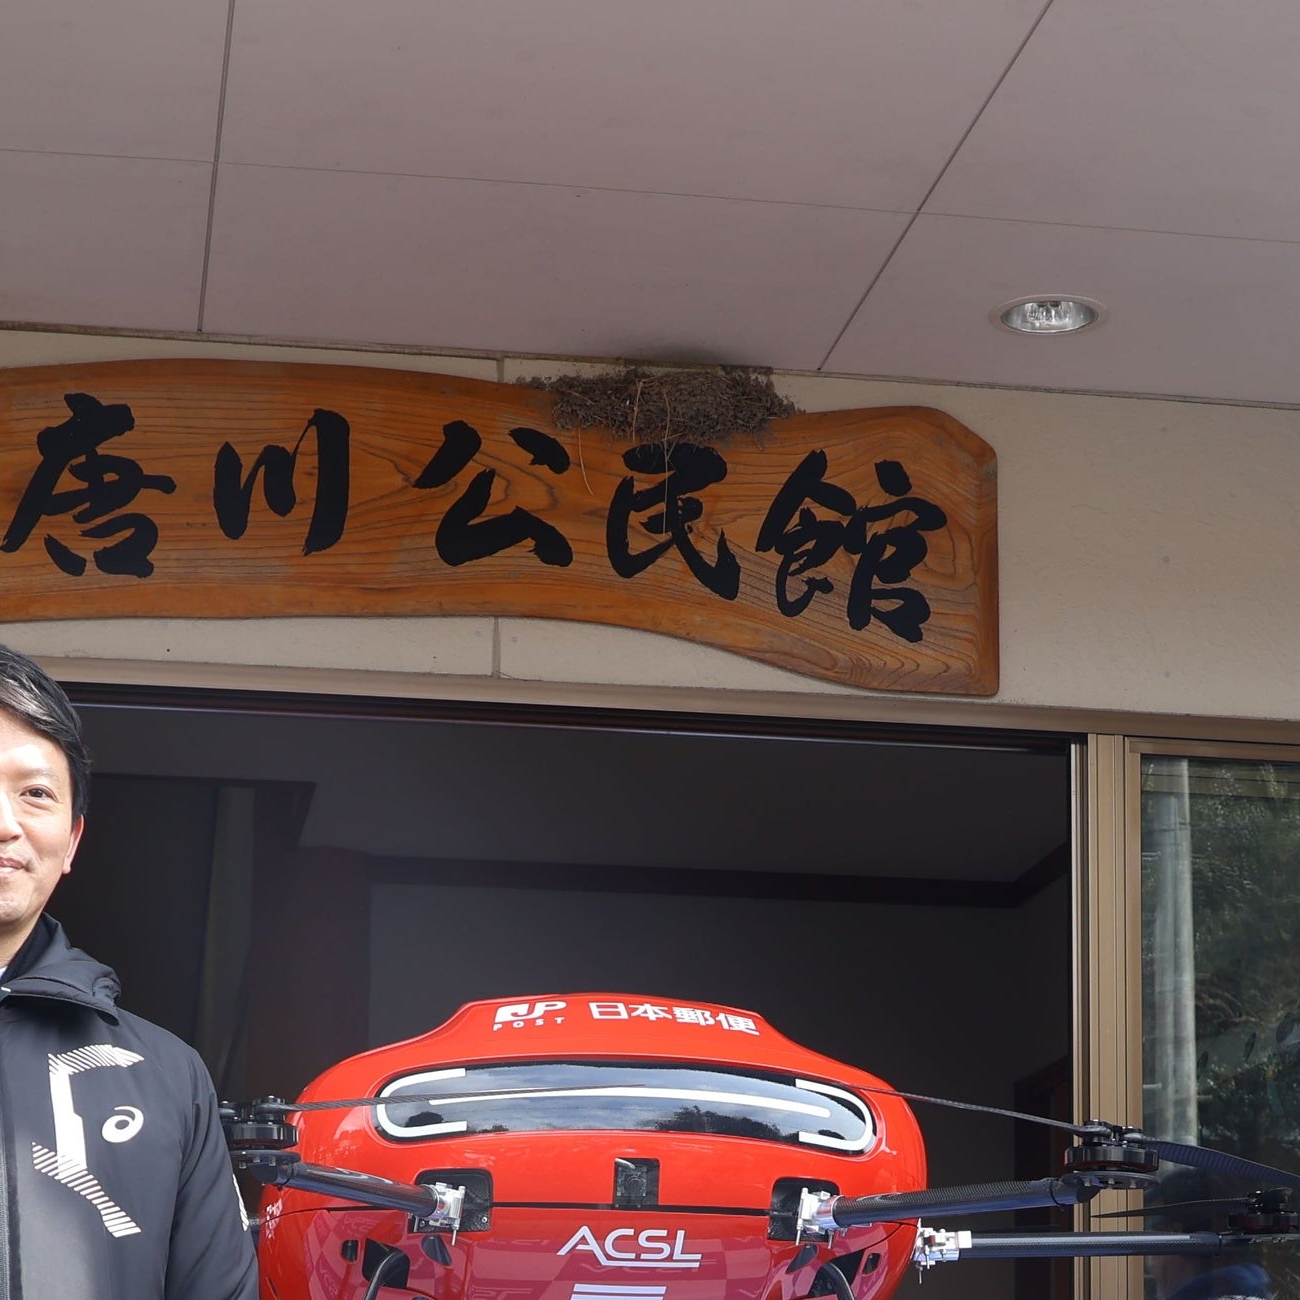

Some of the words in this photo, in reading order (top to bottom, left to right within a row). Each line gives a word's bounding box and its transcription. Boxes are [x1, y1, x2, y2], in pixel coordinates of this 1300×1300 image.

[0, 392, 947, 643] 唐川公民館
[493, 1017, 565, 1032] POST
[588, 1002, 760, 1036] 日本郵便
[556, 1225, 703, 1268] ACSL
